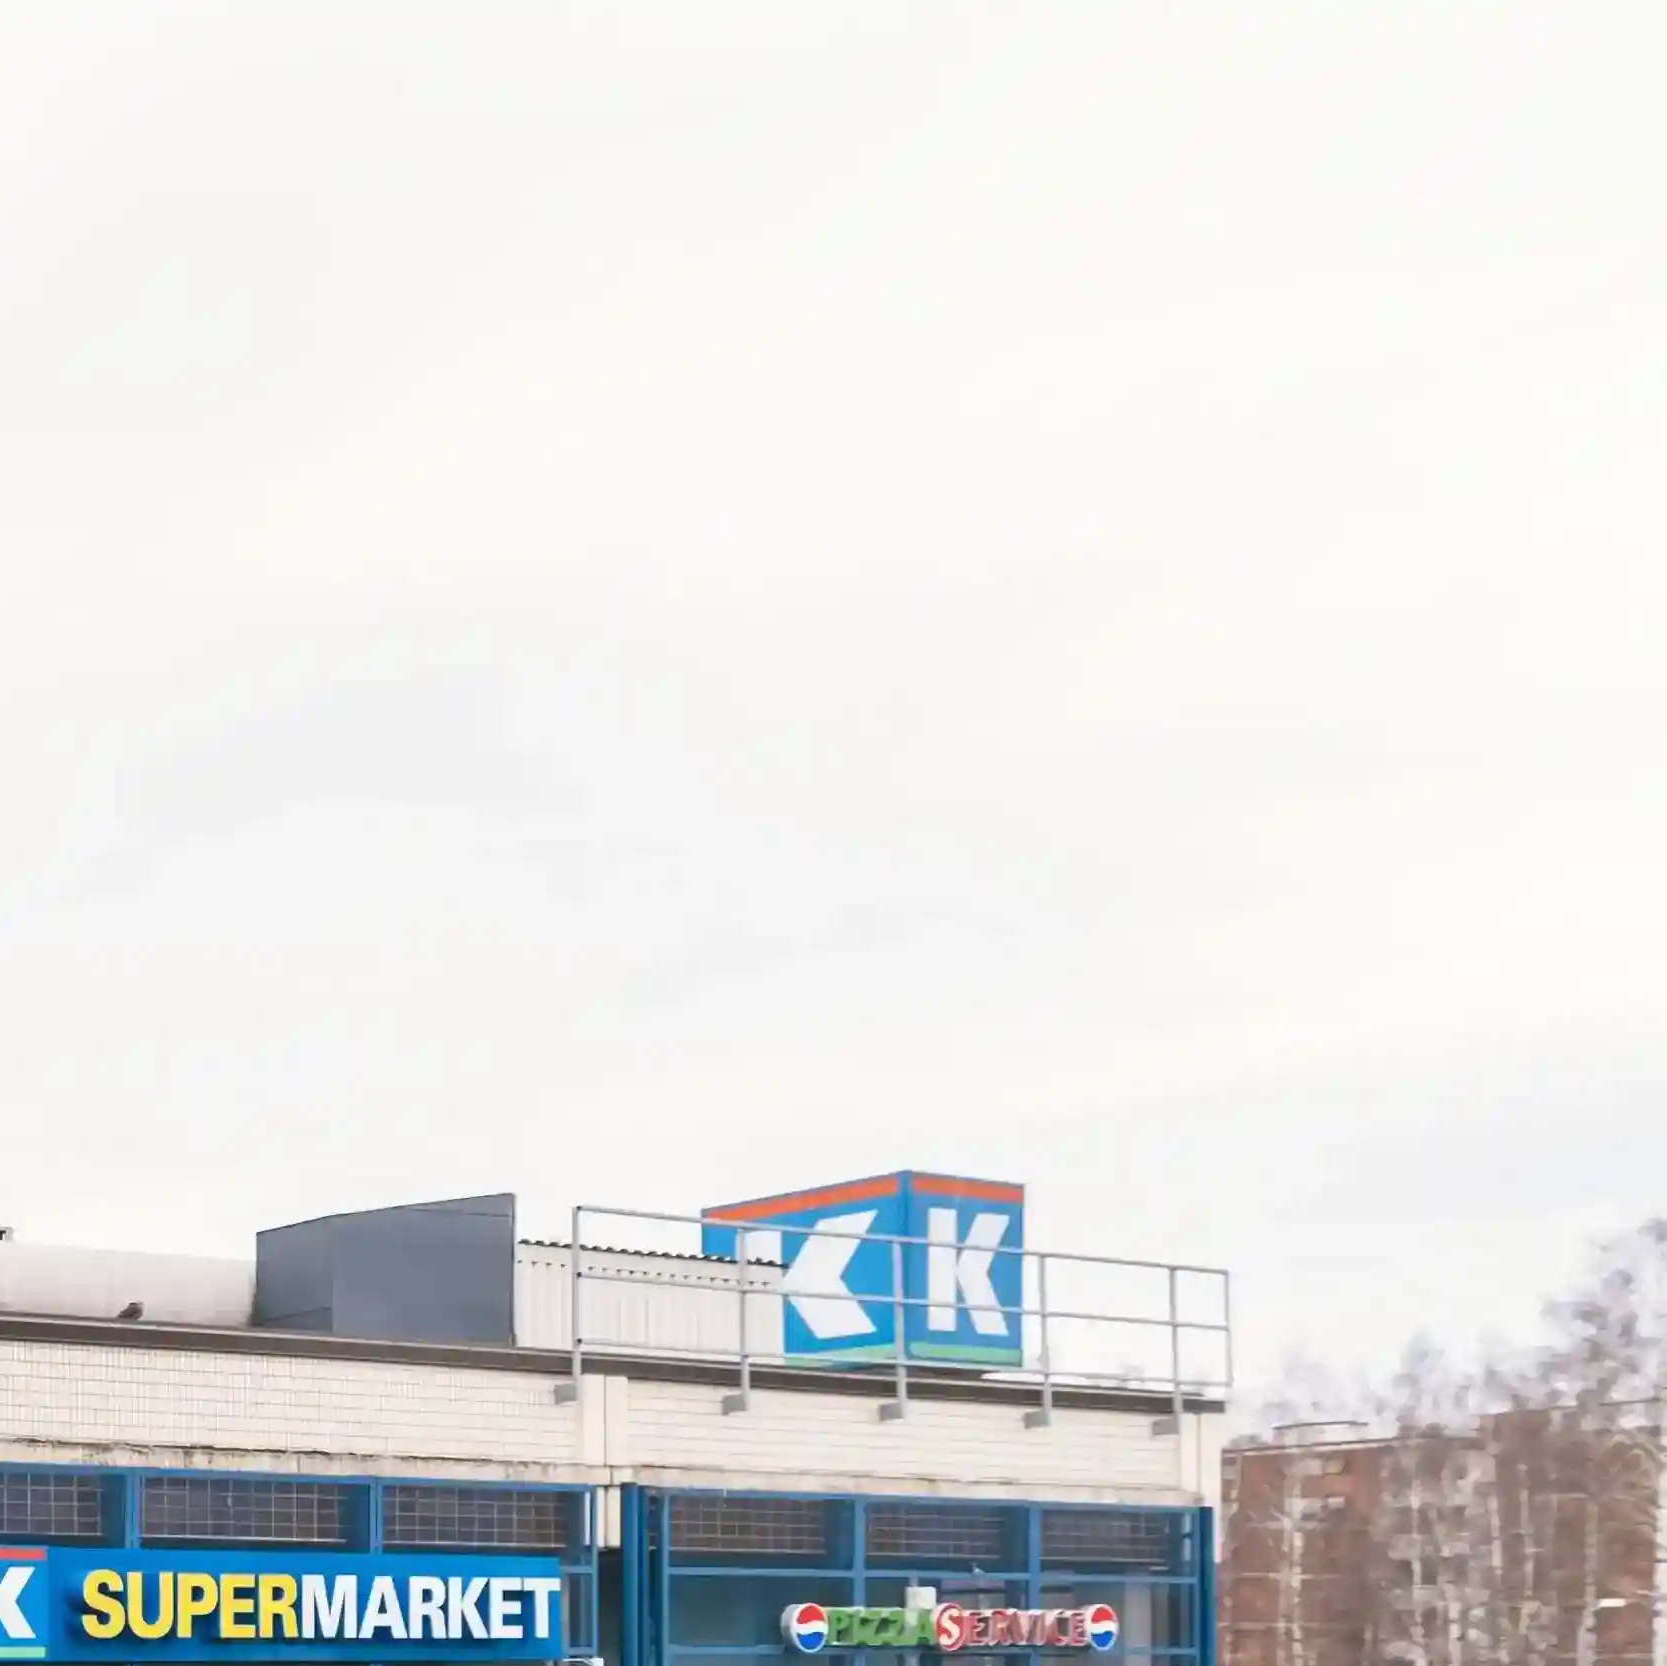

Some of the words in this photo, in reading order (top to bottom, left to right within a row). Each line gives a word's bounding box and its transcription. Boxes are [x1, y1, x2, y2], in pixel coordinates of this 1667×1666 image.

[927, 1207, 1011, 1337] K
[81, 1568, 561, 1641] SUPERMARKET
[828, 1610, 935, 1646] PIZZA
[932, 1601, 1091, 1650] SERVICE
